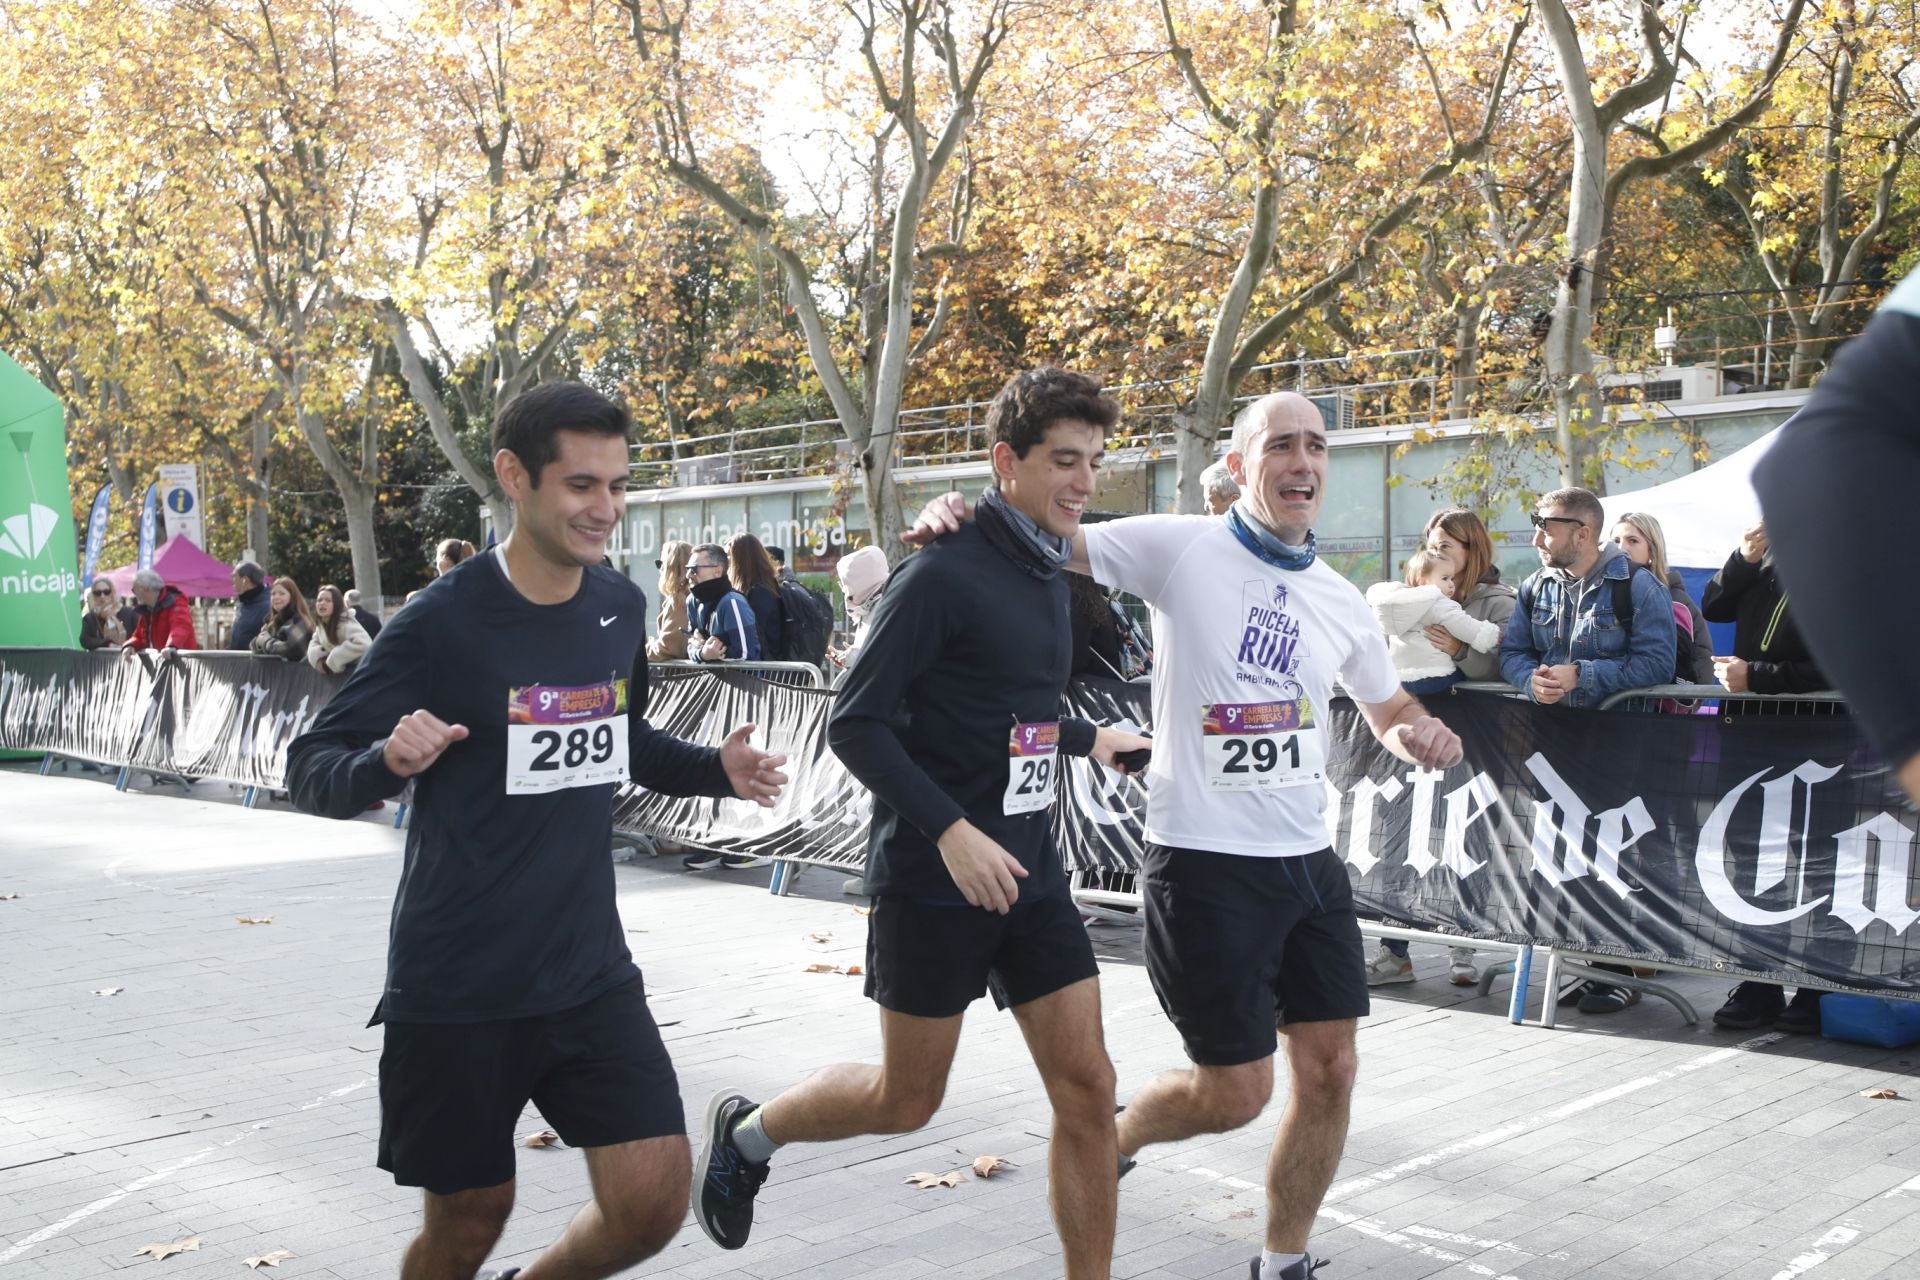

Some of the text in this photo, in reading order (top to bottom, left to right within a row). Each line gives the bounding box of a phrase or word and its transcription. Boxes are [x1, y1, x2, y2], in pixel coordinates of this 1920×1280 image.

[665, 513, 748, 545] ciudad
[759, 507, 847, 557] amiga
[0, 567, 76, 599] nicaja
[1248, 606, 1300, 638] PUCELA
[1238, 626, 1298, 675] RUN
[560, 698, 601, 712] EMPRESAS
[1226, 707, 1242, 724] 9ª
[1243, 705, 1273, 715] CARRERA
[1243, 713, 1283, 724] EMPRESAS
[529, 724, 613, 772] 289
[1222, 734, 1300, 774] 291
[1525, 751, 1657, 899] de
[1694, 759, 1920, 937] Ca
